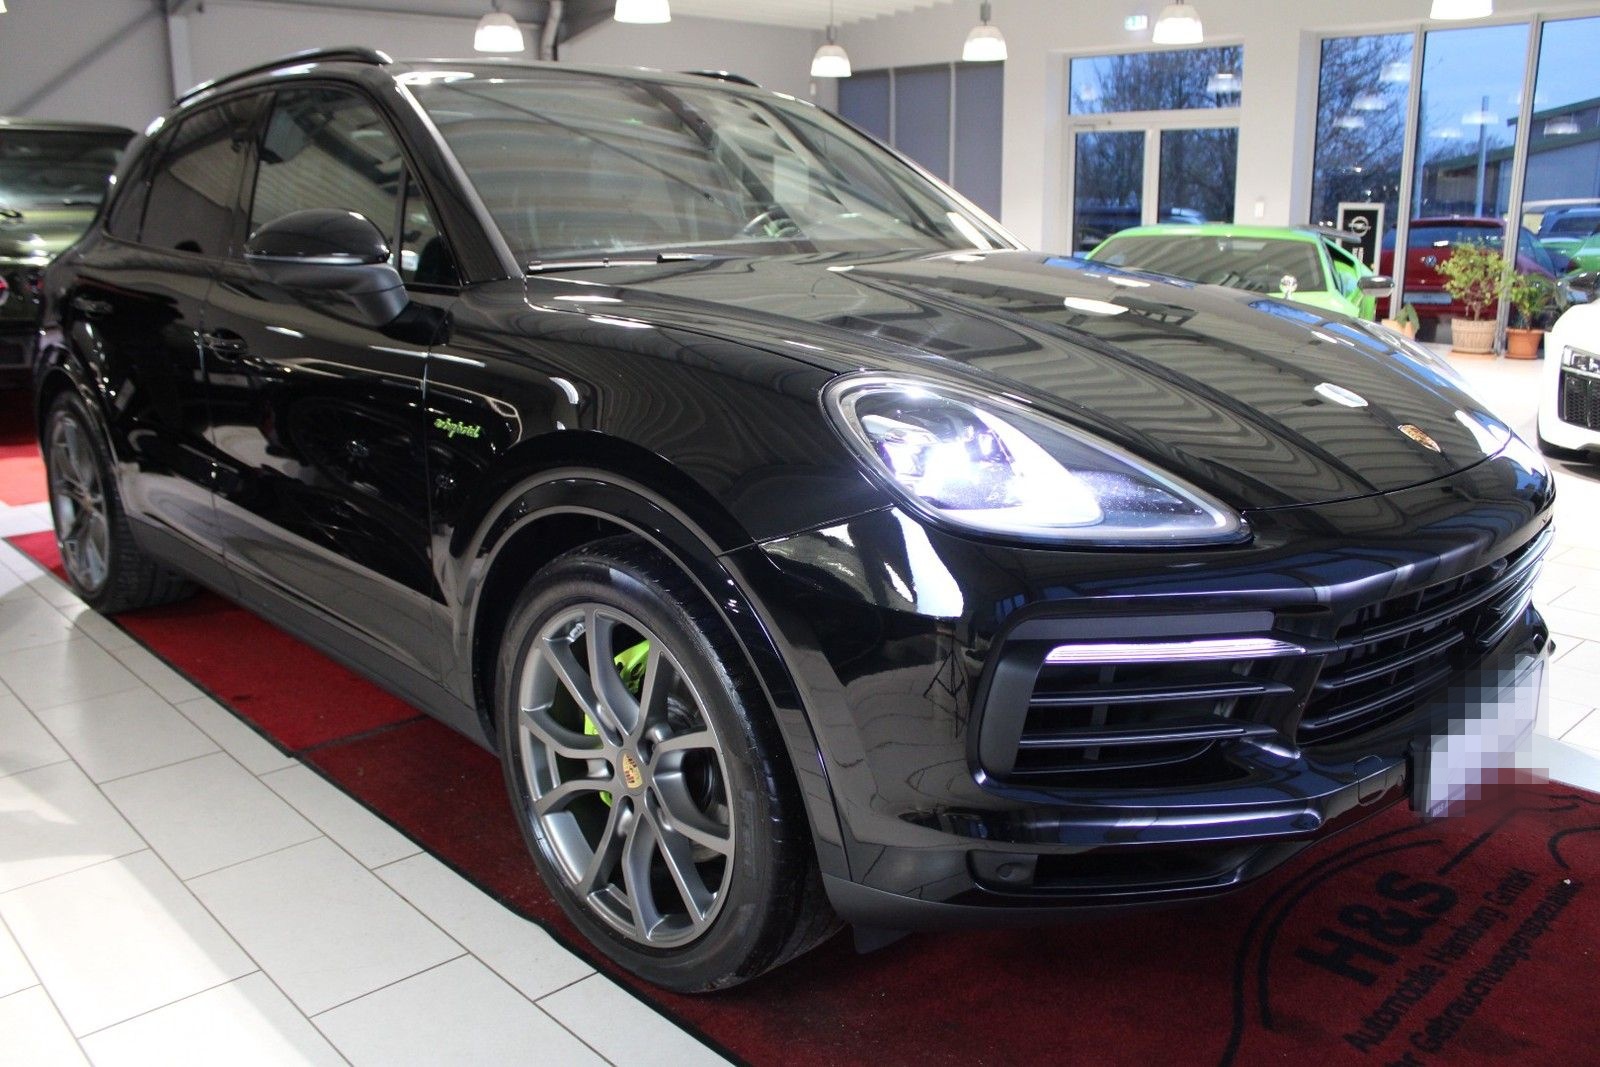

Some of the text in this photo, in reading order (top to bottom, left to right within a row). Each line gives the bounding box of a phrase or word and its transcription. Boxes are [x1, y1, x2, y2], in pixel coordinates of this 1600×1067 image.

[1294, 870, 1460, 986] H&S
[1343, 963, 1445, 1053] Automobile
[1425, 905, 1508, 965] Hamburg
